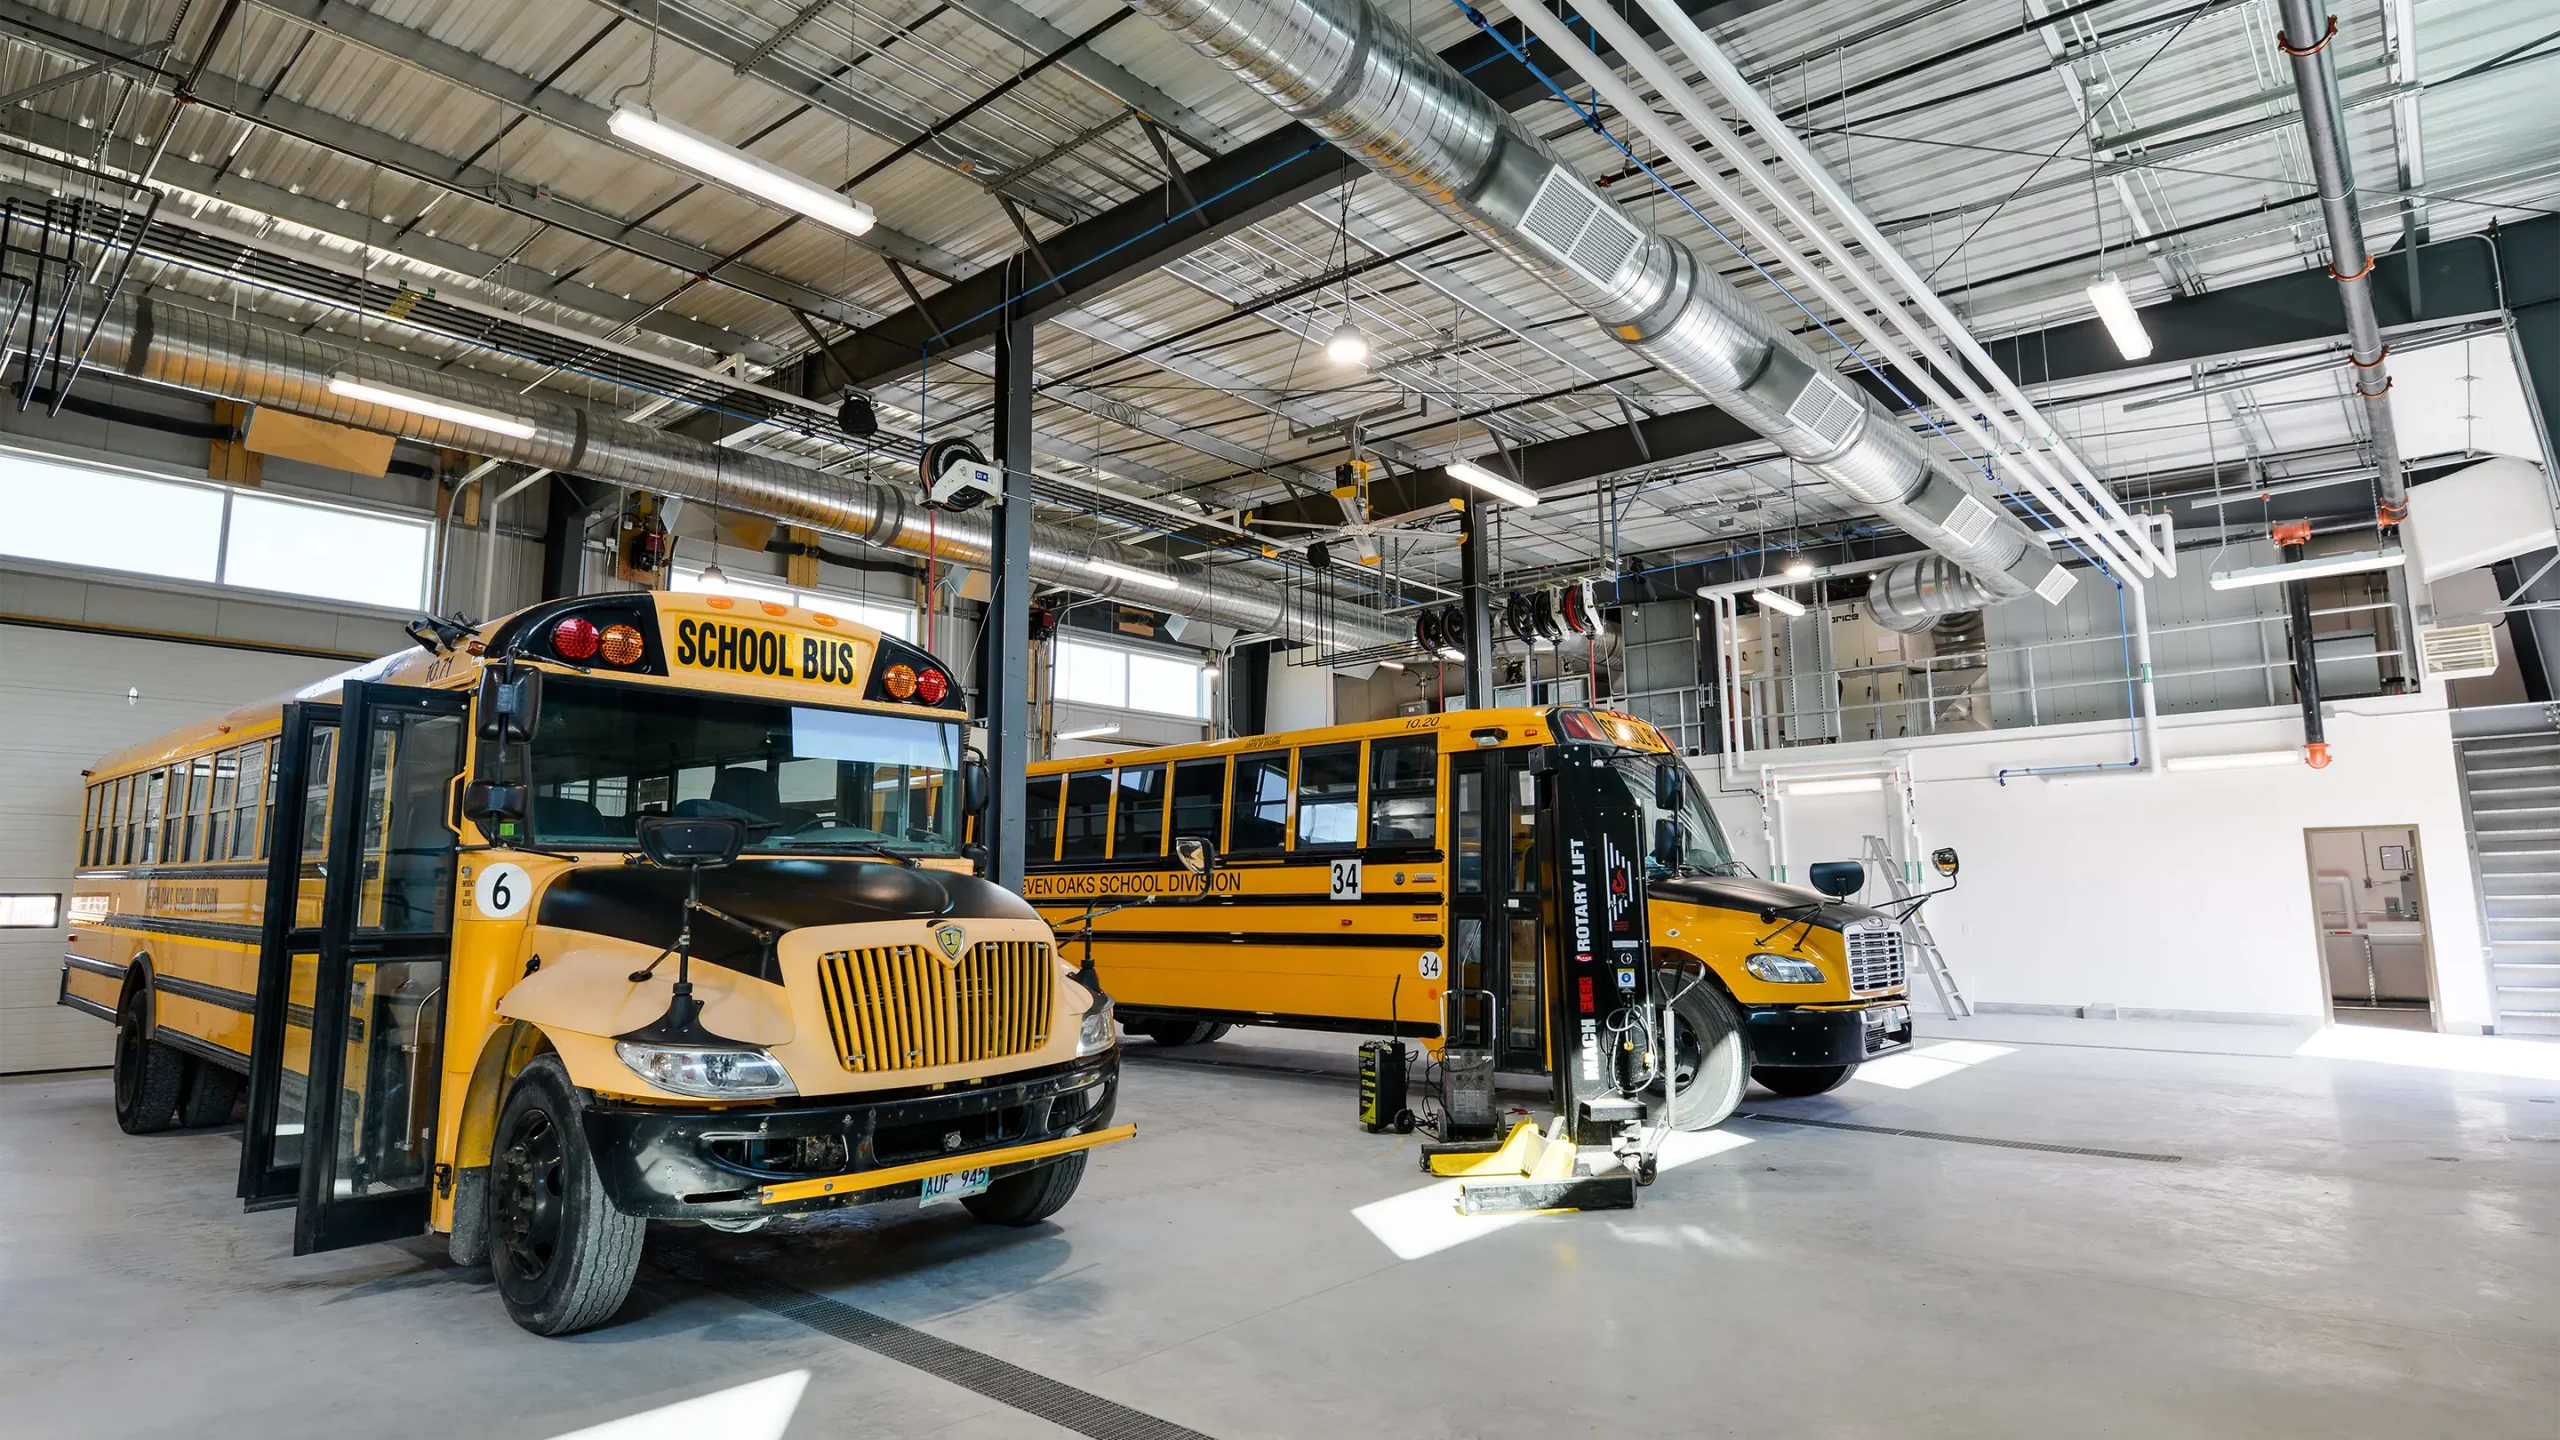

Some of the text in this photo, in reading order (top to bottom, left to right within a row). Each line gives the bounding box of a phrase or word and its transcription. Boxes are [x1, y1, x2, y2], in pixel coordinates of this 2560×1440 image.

[677, 618, 853, 685] SCHOOL BUS
[1405, 716, 1440, 729] 10.20
[492, 871, 511, 910] 6
[1024, 872, 1241, 895] EVEN OAKS SCHOOL DIVISION
[1332, 863, 1358, 894] 34
[1570, 838, 1591, 952] ROTARY LIFT
[1421, 955, 1439, 977] 34
[1580, 1018, 1600, 1081] MACH
[925, 1168, 986, 1197] AUF 945
